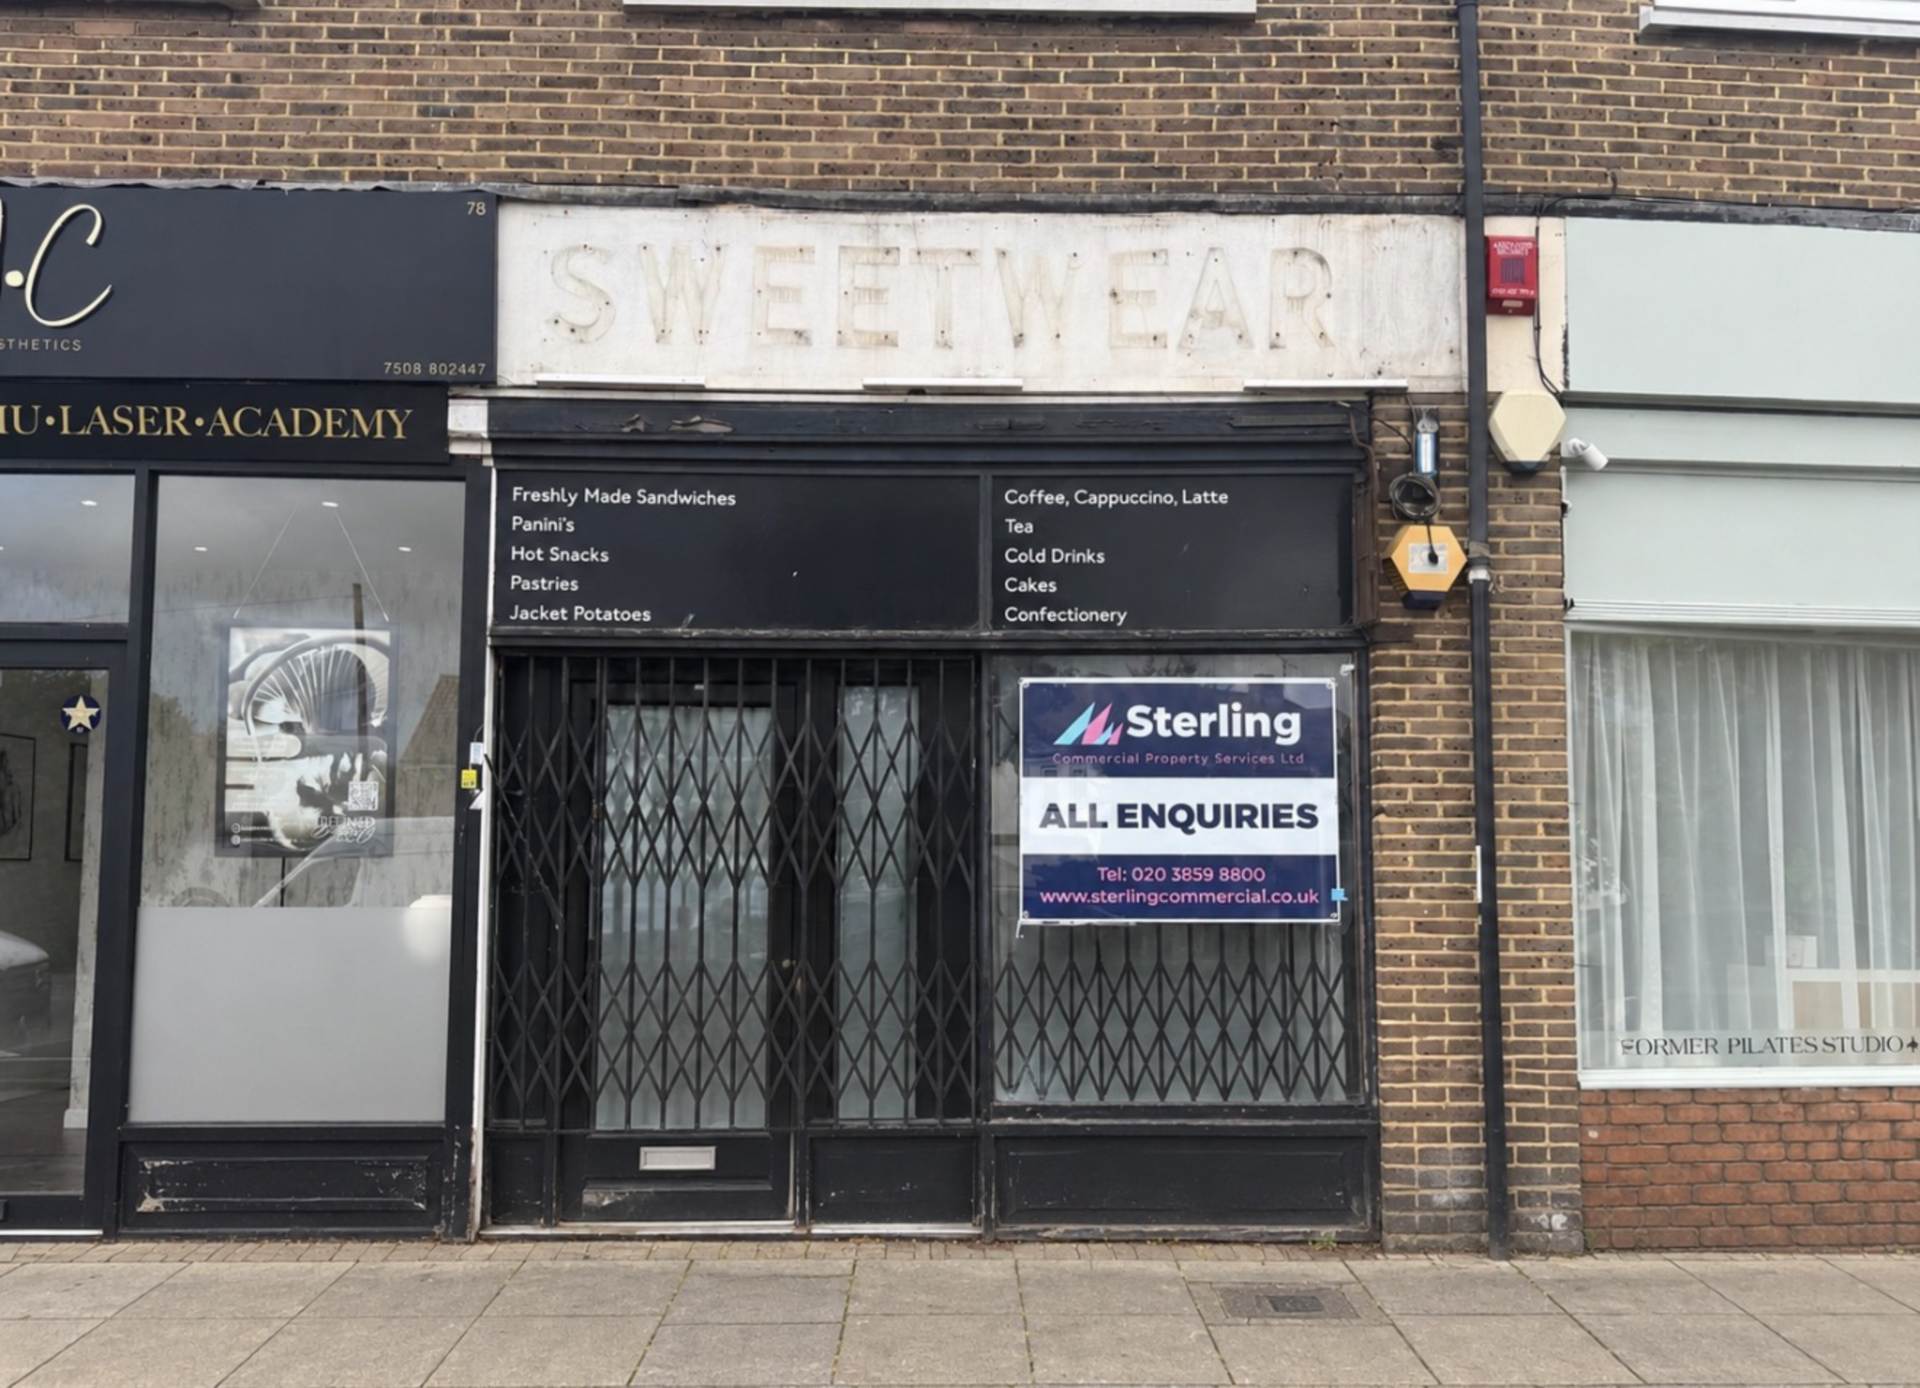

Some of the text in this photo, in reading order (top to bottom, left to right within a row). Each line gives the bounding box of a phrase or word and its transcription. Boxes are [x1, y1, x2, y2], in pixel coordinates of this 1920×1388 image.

[467, 201, 487, 216] 78
[550, 243, 1335, 350] SWEETWEAR
[383, 361, 486, 376] 7508 802447
[512, 486, 737, 507] Freshly Made Sandwiches
[1004, 489, 1229, 508] Coffee, Cappuccino, Latte
[511, 516, 575, 532] Panini's
[1005, 519, 1034, 533] Tea
[511, 546, 610, 562] Hot Snacks
[1004, 548, 1105, 563] Cold Drinks
[510, 575, 579, 591] Pastries
[1004, 577, 1057, 592] Cakes
[509, 605, 652, 621] Jacket Potatoes
[1004, 606, 1127, 626] Confectionery
[1126, 702, 1301, 745] Sterling
[1052, 752, 1305, 766] Commercial Property Services Ltd
[1038, 803, 1319, 835] ALL ENQUIRIES
[1097, 867, 1266, 882] Tel: 020 3859 8800
[1040, 887, 1320, 906] www.sterlingcommercial.co.uk
[1728, 1037, 1818, 1055] PILATES
[1822, 1035, 1904, 1054] STUDIO
